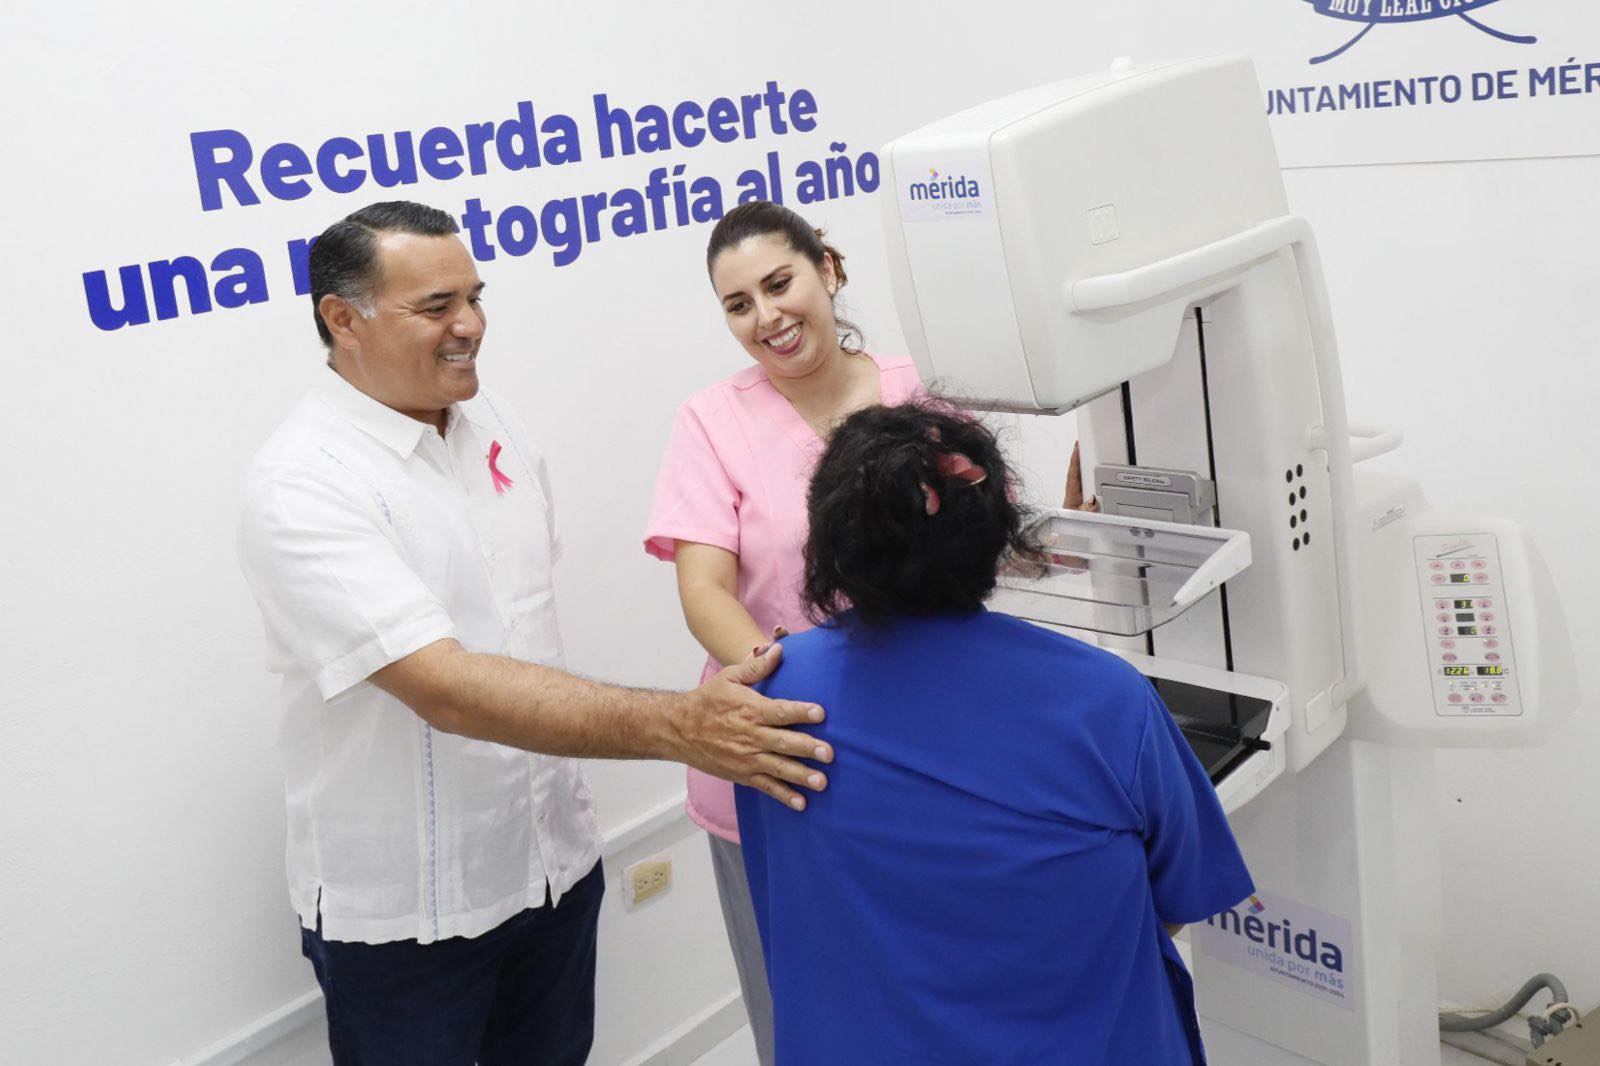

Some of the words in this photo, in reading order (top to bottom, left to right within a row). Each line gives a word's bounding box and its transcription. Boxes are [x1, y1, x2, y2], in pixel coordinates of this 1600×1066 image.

[1380, 0, 1432, 16] LEAL
[1471, 69, 1519, 101] DE
[190, 100, 582, 212] Recuerda
[593, 80, 818, 159] hacerte
[82, 247, 270, 332] una
[287, 163, 724, 297] tografía
[736, 150, 784, 207] al
[793, 141, 881, 205] año
[1247, 945, 1285, 967] unida
[1288, 961, 1312, 976] por
[1315, 970, 1345, 989] más
